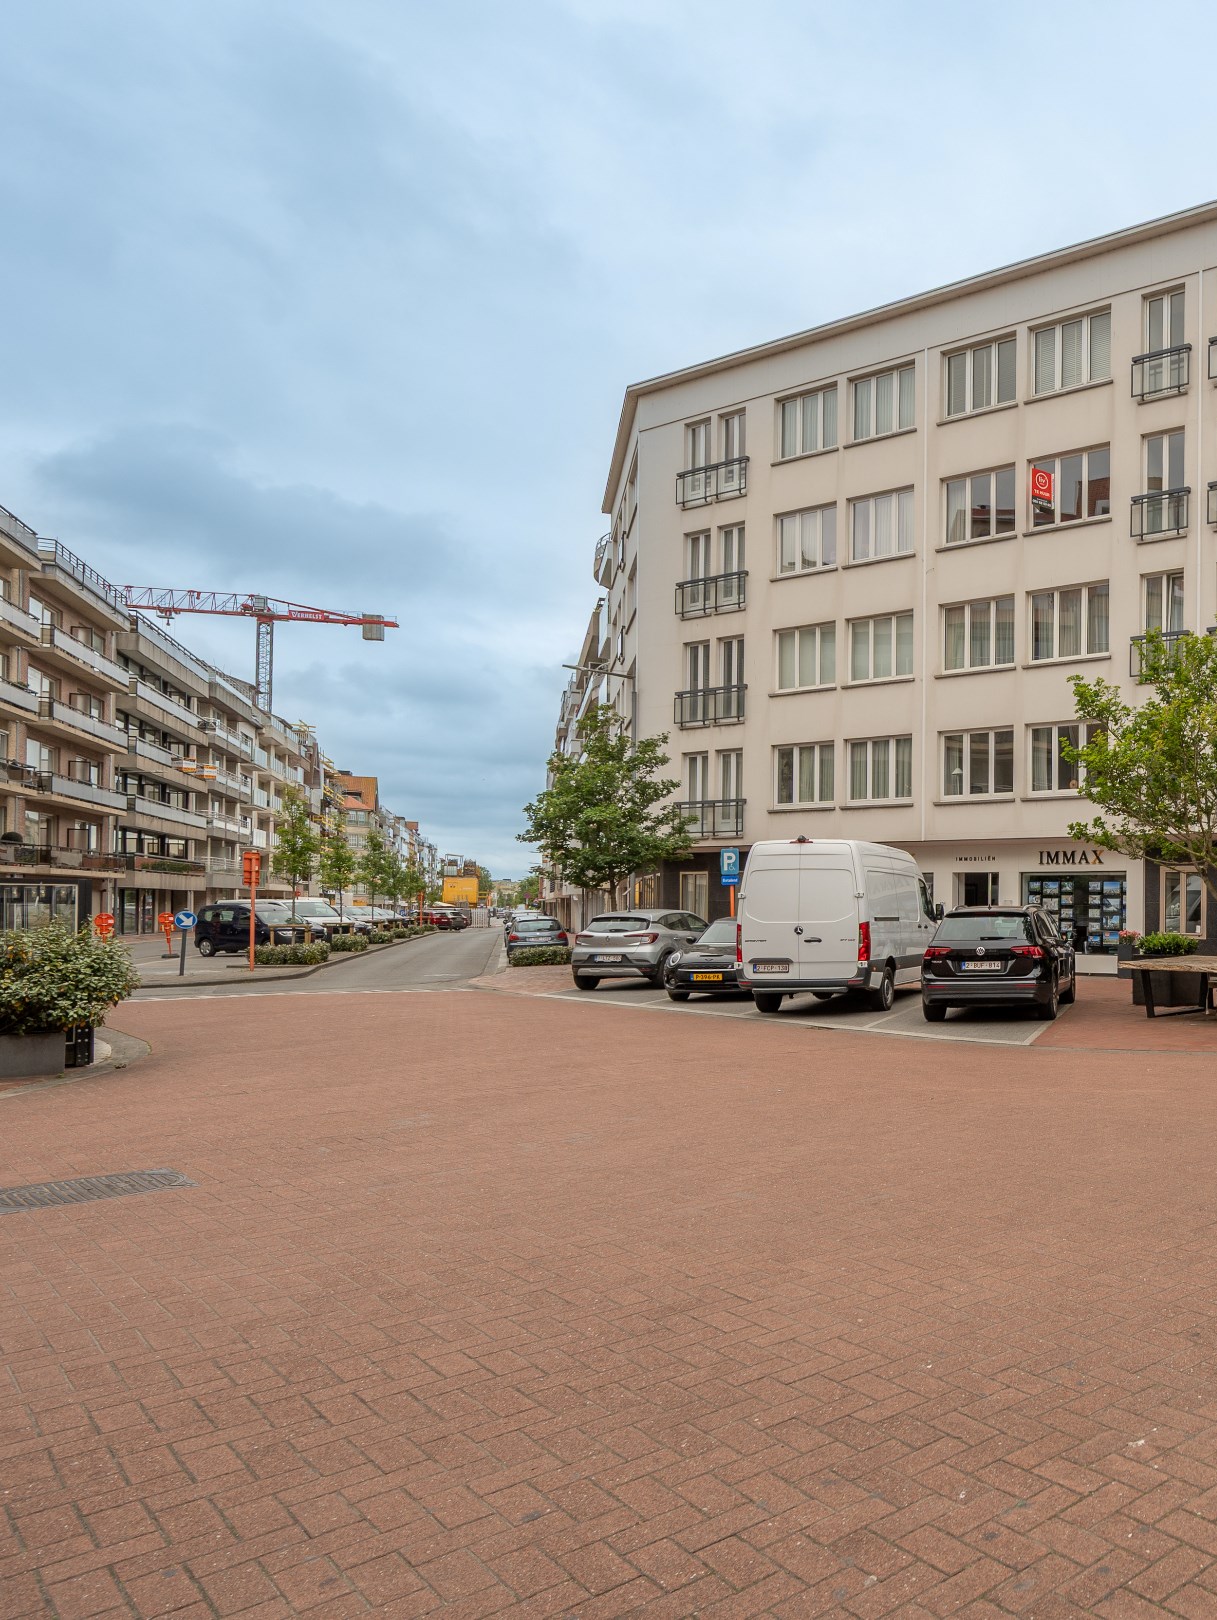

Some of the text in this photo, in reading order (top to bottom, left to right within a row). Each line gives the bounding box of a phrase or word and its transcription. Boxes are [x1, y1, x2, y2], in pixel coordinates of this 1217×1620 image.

[723, 852, 736, 871] P
[1038, 850, 1105, 865] IMMAX
[965, 961, 1000, 969] 2-BUF-814
